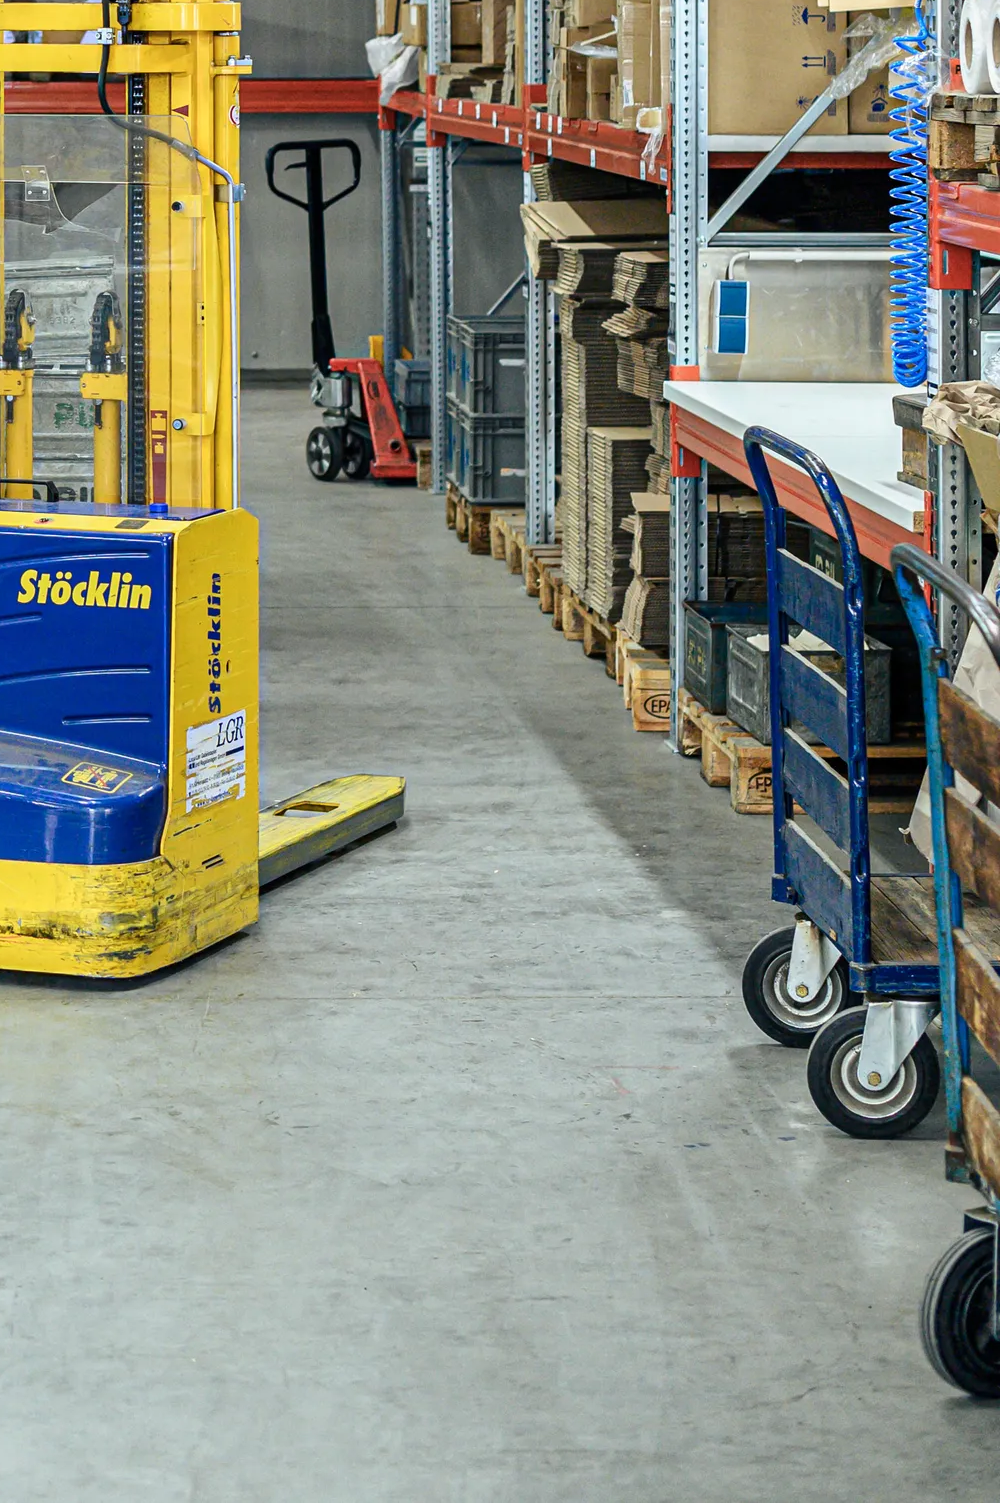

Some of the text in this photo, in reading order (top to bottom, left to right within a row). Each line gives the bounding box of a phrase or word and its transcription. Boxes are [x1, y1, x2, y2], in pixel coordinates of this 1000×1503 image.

[17, 569, 152, 610] Stöcklin
[207, 573, 222, 714] Stöcklin
[216, 716, 244, 747] LGR
